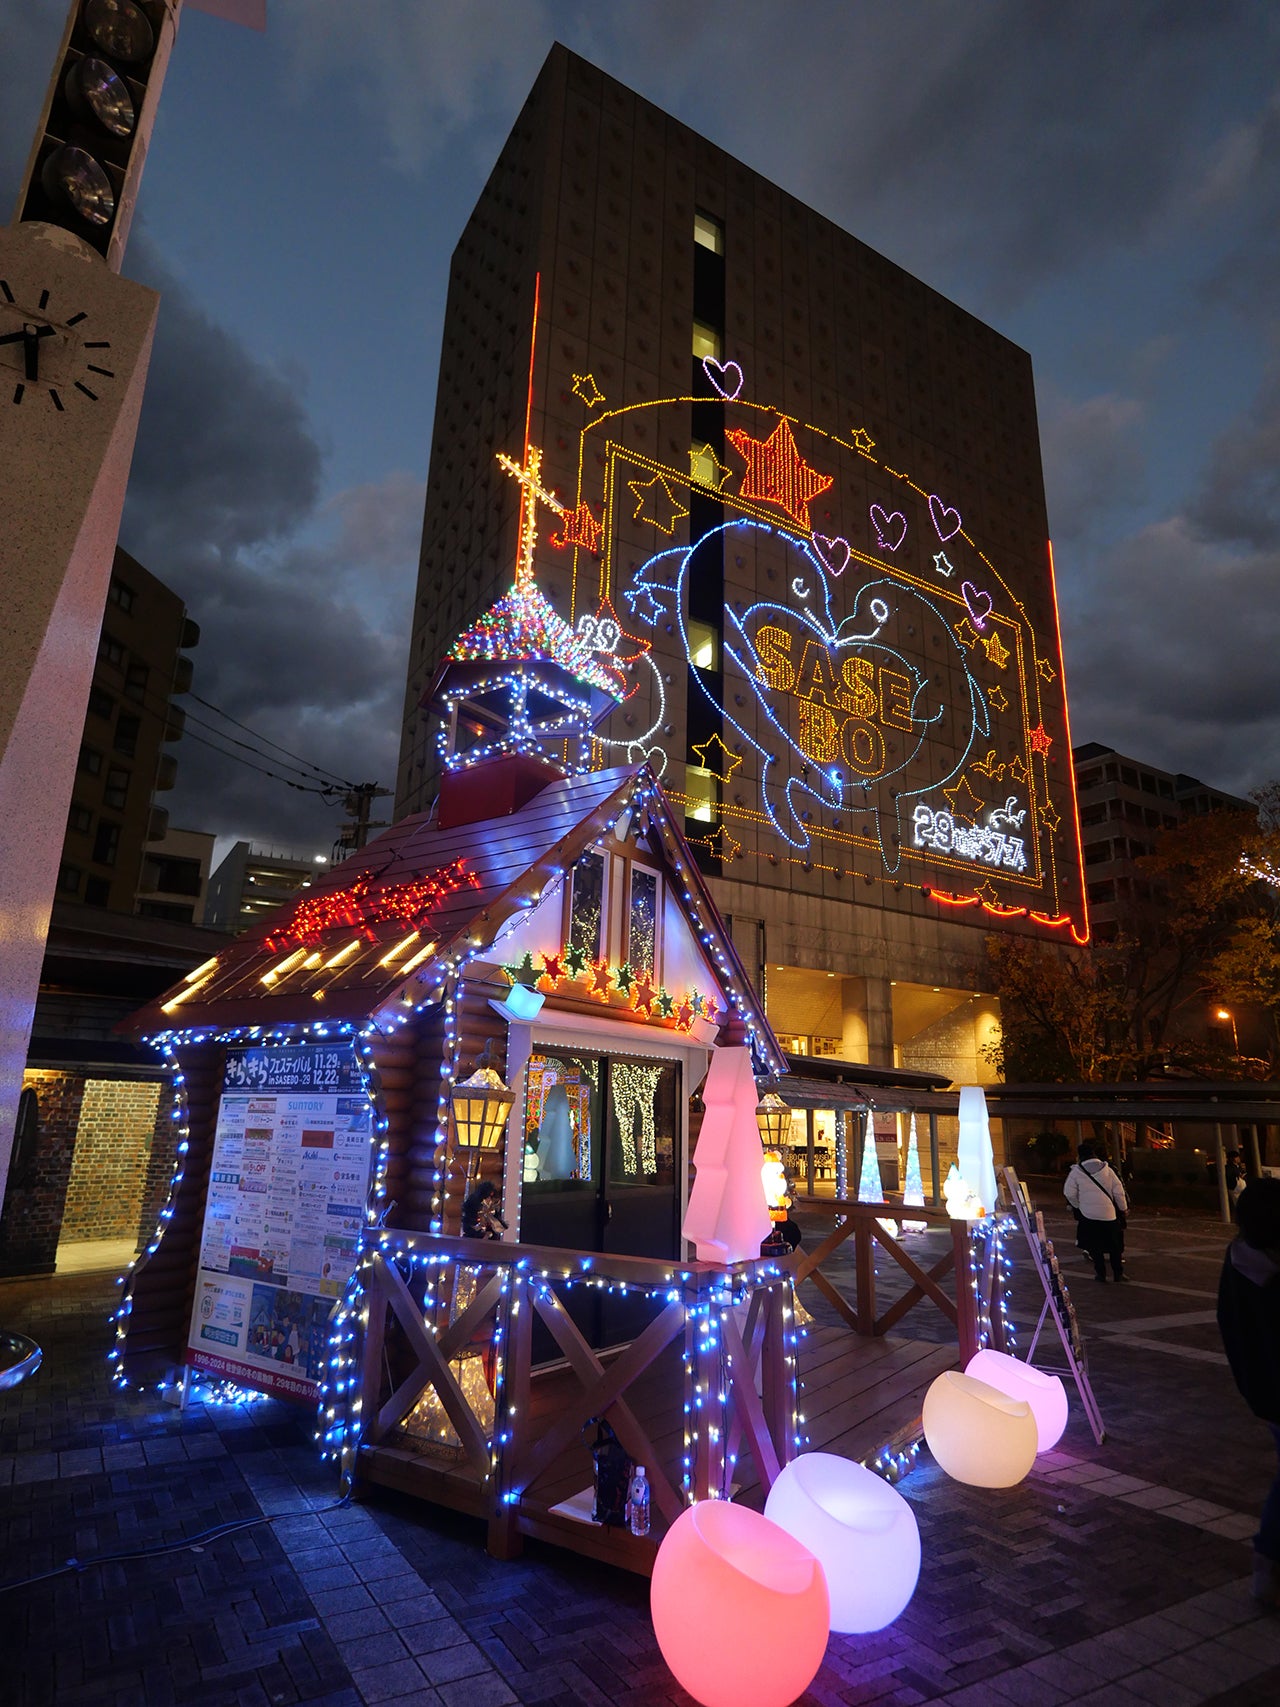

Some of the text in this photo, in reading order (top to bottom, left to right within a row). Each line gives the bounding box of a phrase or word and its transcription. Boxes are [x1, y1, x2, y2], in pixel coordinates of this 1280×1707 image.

[577, 614, 621, 653] 29
[225, 1055, 311, 1086] きらきら フェスティバル
